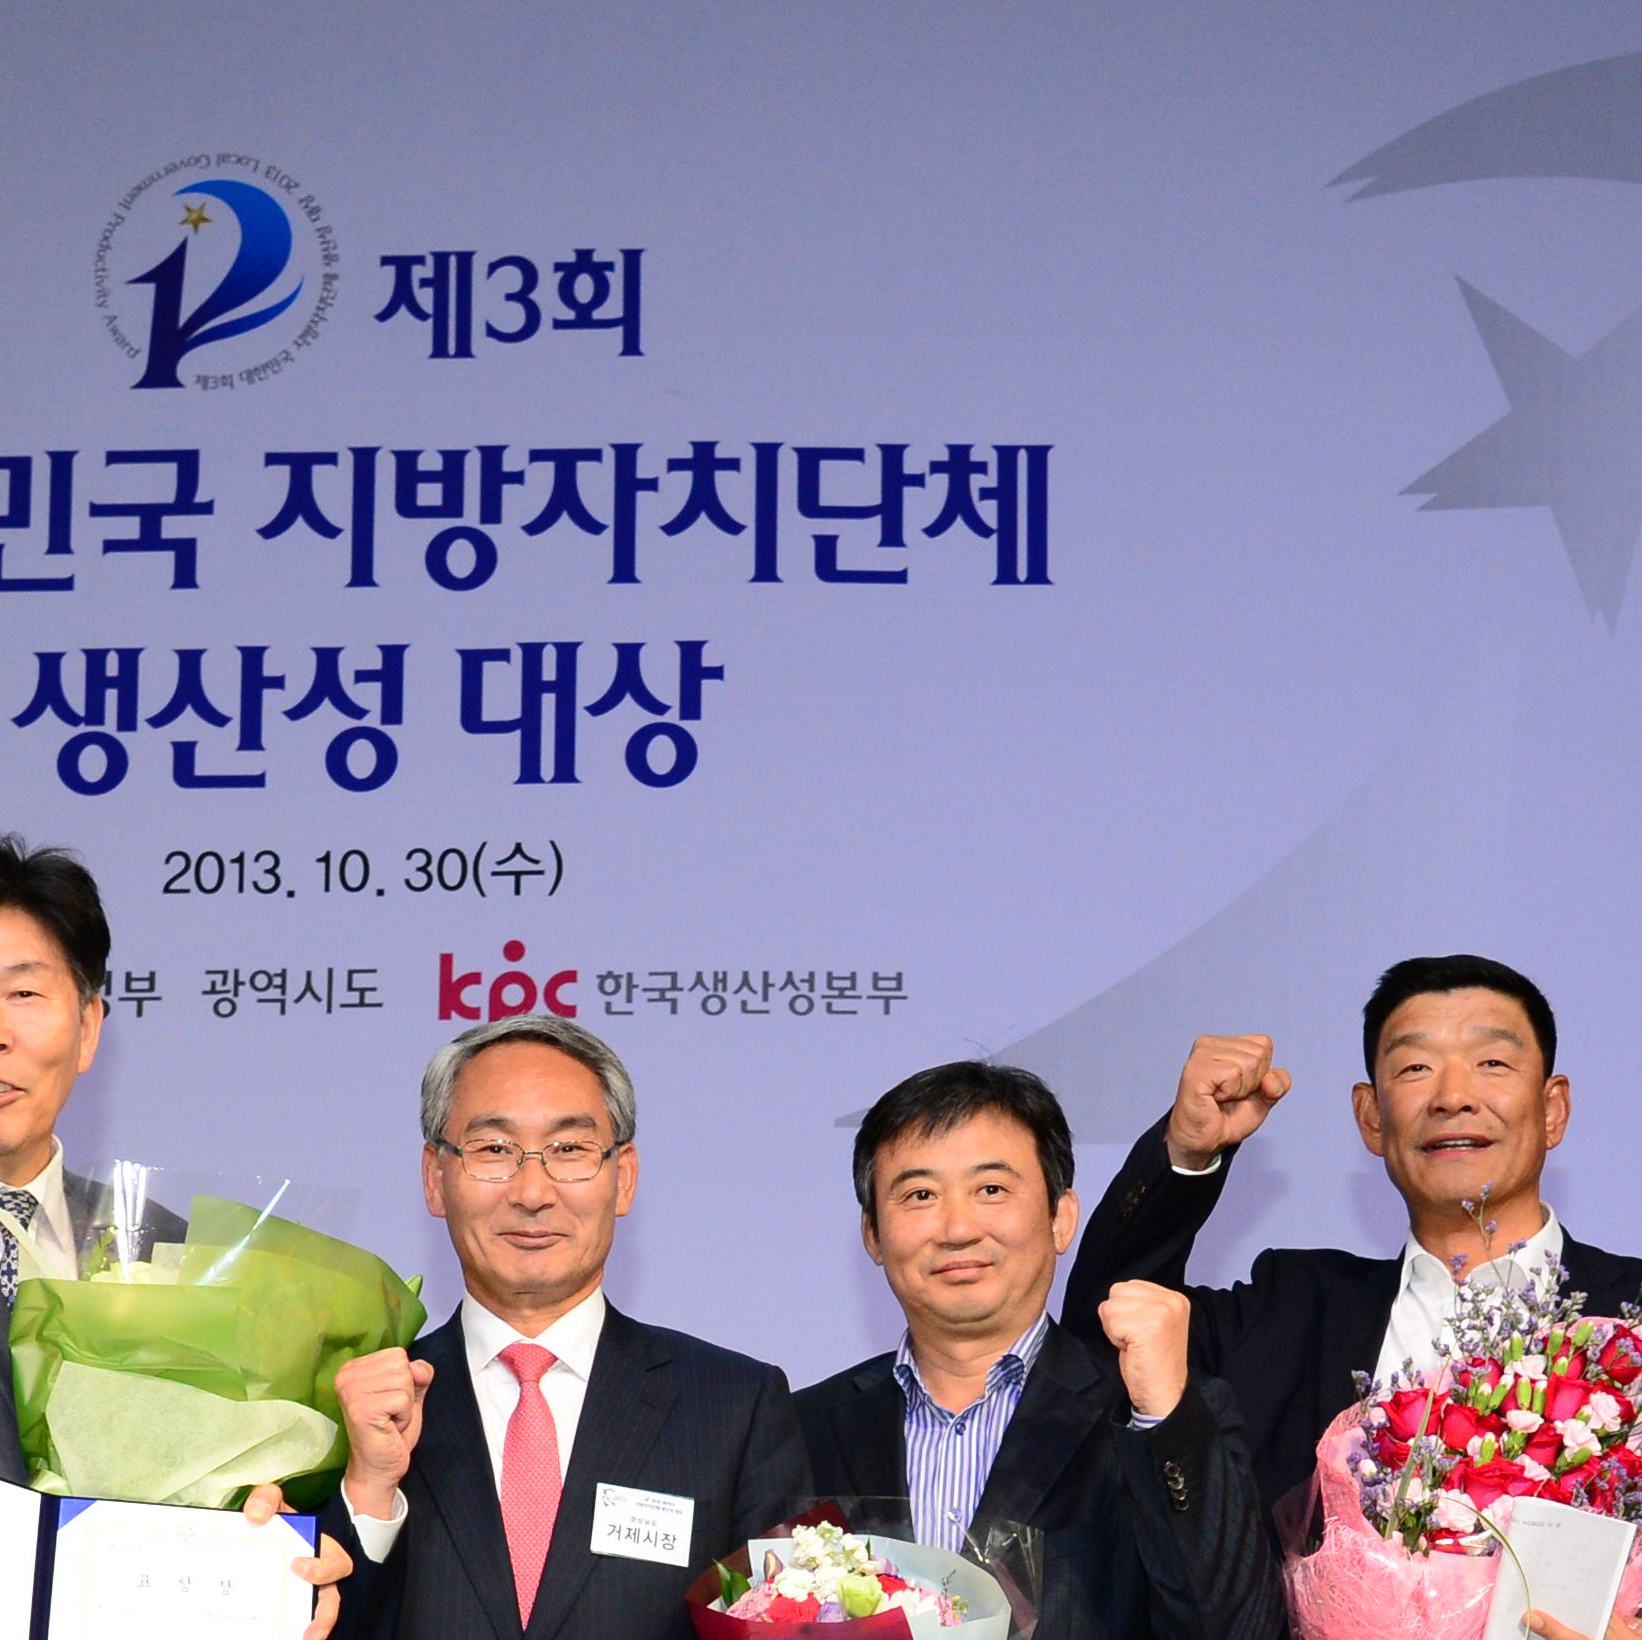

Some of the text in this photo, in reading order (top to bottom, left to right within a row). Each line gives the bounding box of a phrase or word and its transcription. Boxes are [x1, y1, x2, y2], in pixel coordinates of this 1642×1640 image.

[92, 152, 301, 360] 2013 Local Government Productivity Award
[374, 248, 645, 360] 제3회
[255, 440, 1056, 592] 지방자치단체
[10, 640, 725, 796] 생산성 대상
[162, 839, 565, 899] 2013. 10. 30(수)
[201, 967, 384, 1019] 광역시도
[438, 939, 578, 1023] kpc
[596, 969, 909, 1017] 한국생산성본부
[606, 1523, 677, 1551] 거제시장
